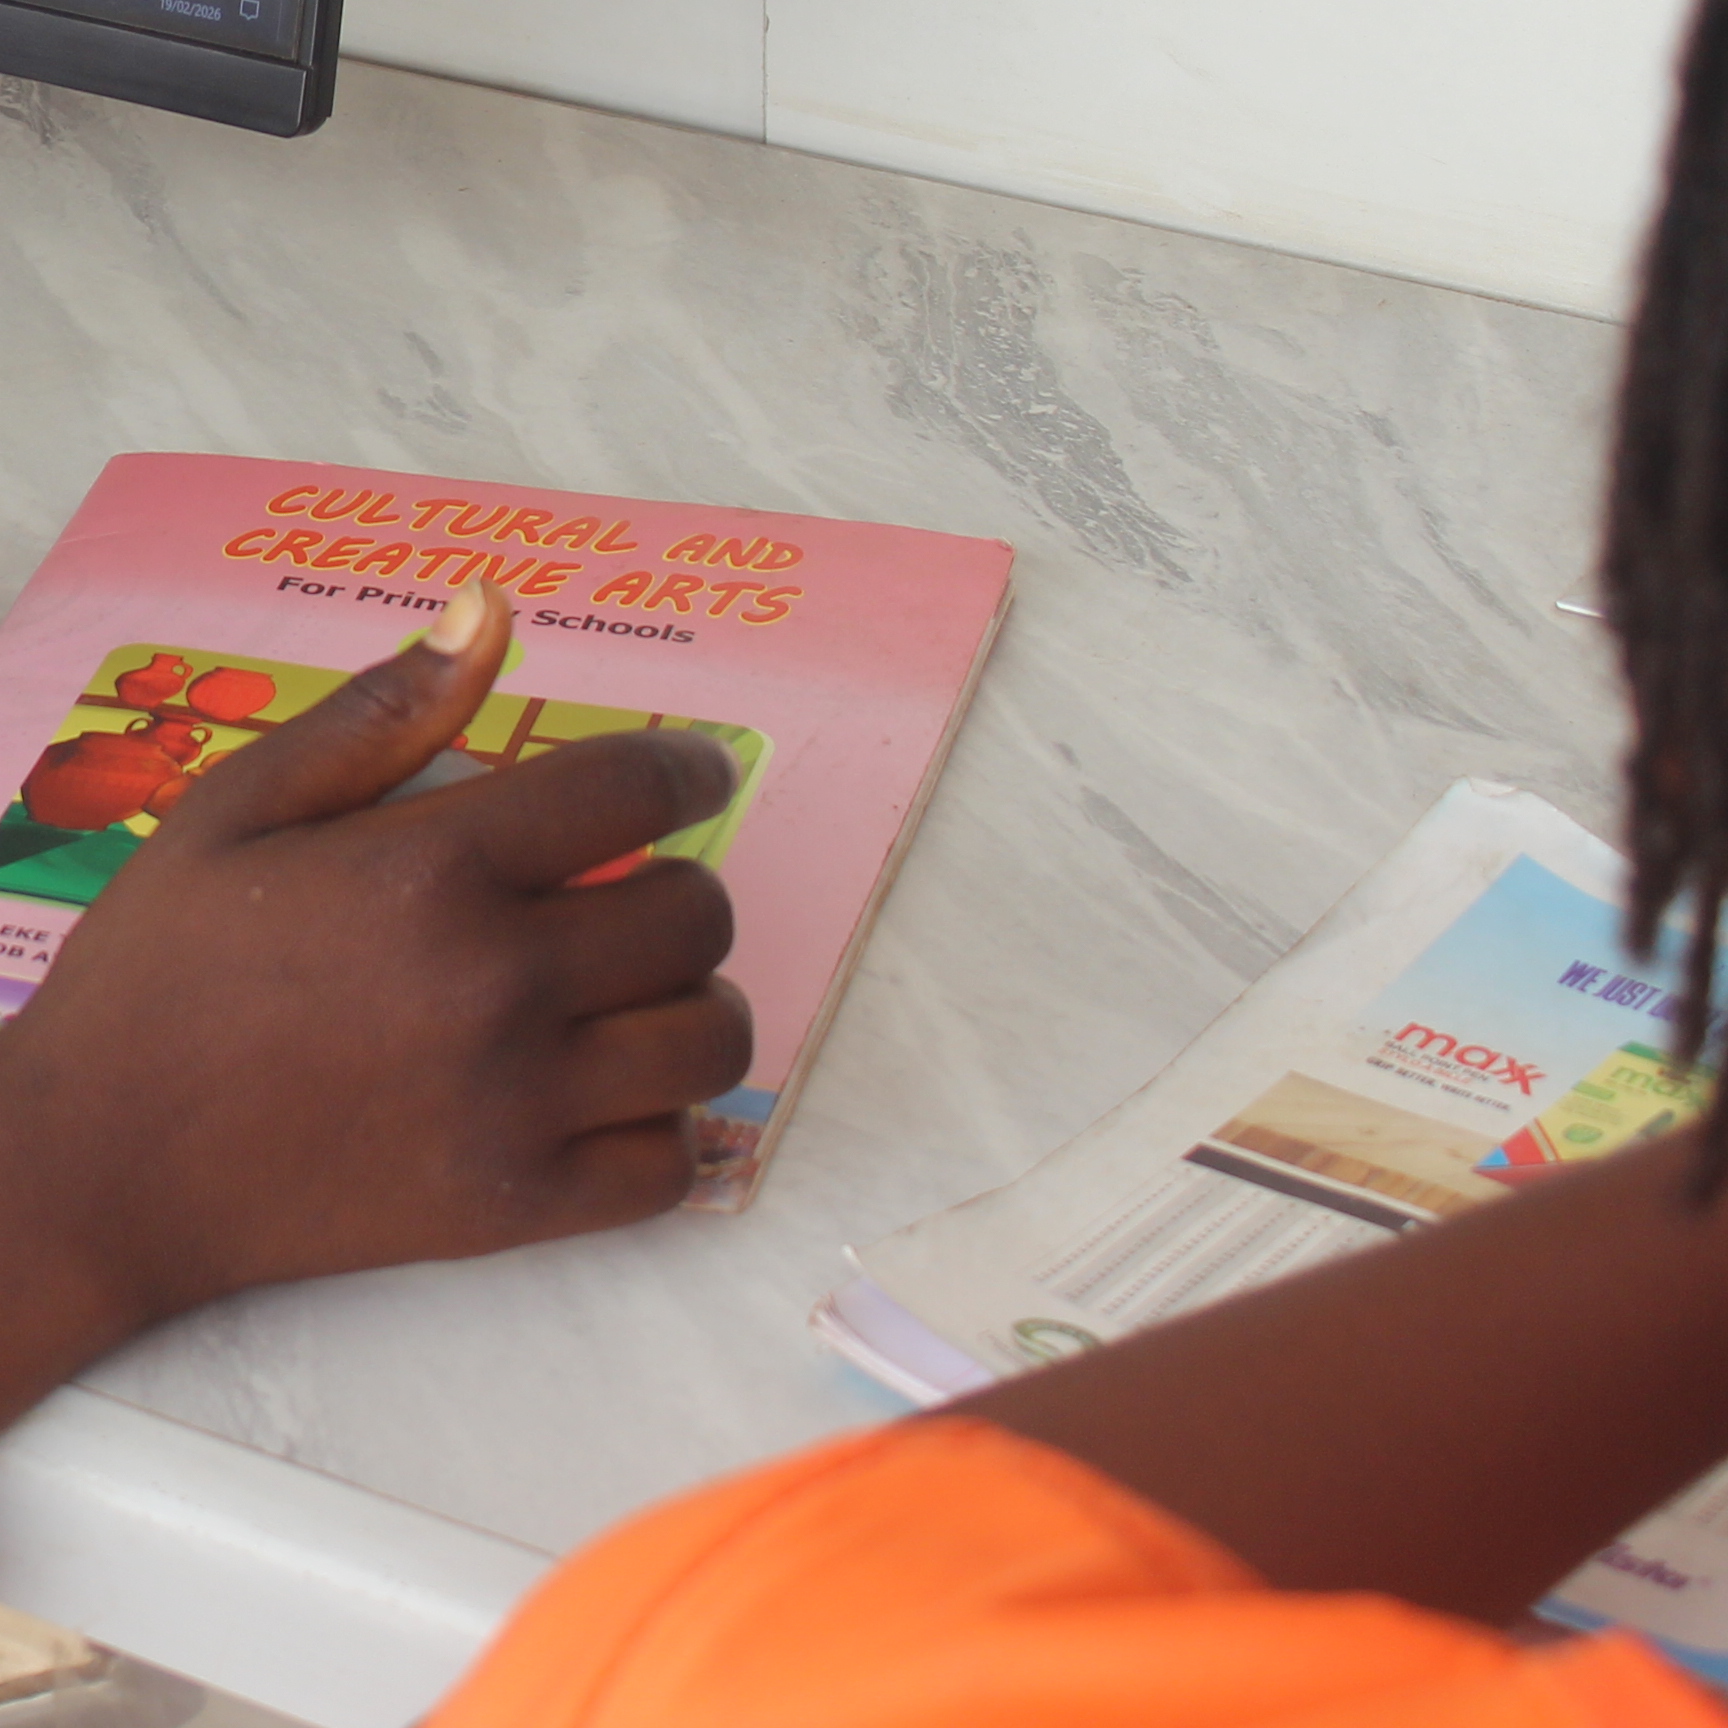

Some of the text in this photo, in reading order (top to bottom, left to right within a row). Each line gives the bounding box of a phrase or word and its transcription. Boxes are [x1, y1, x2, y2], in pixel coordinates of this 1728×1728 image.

[266, 484, 805, 572] CULTURAL AND
[223, 527, 805, 626] CREATIVE ARTS
[276, 575, 696, 645] For Prim Schools
[1557, 958, 1609, 993] WE
[1592, 973, 1663, 1011] JUST
